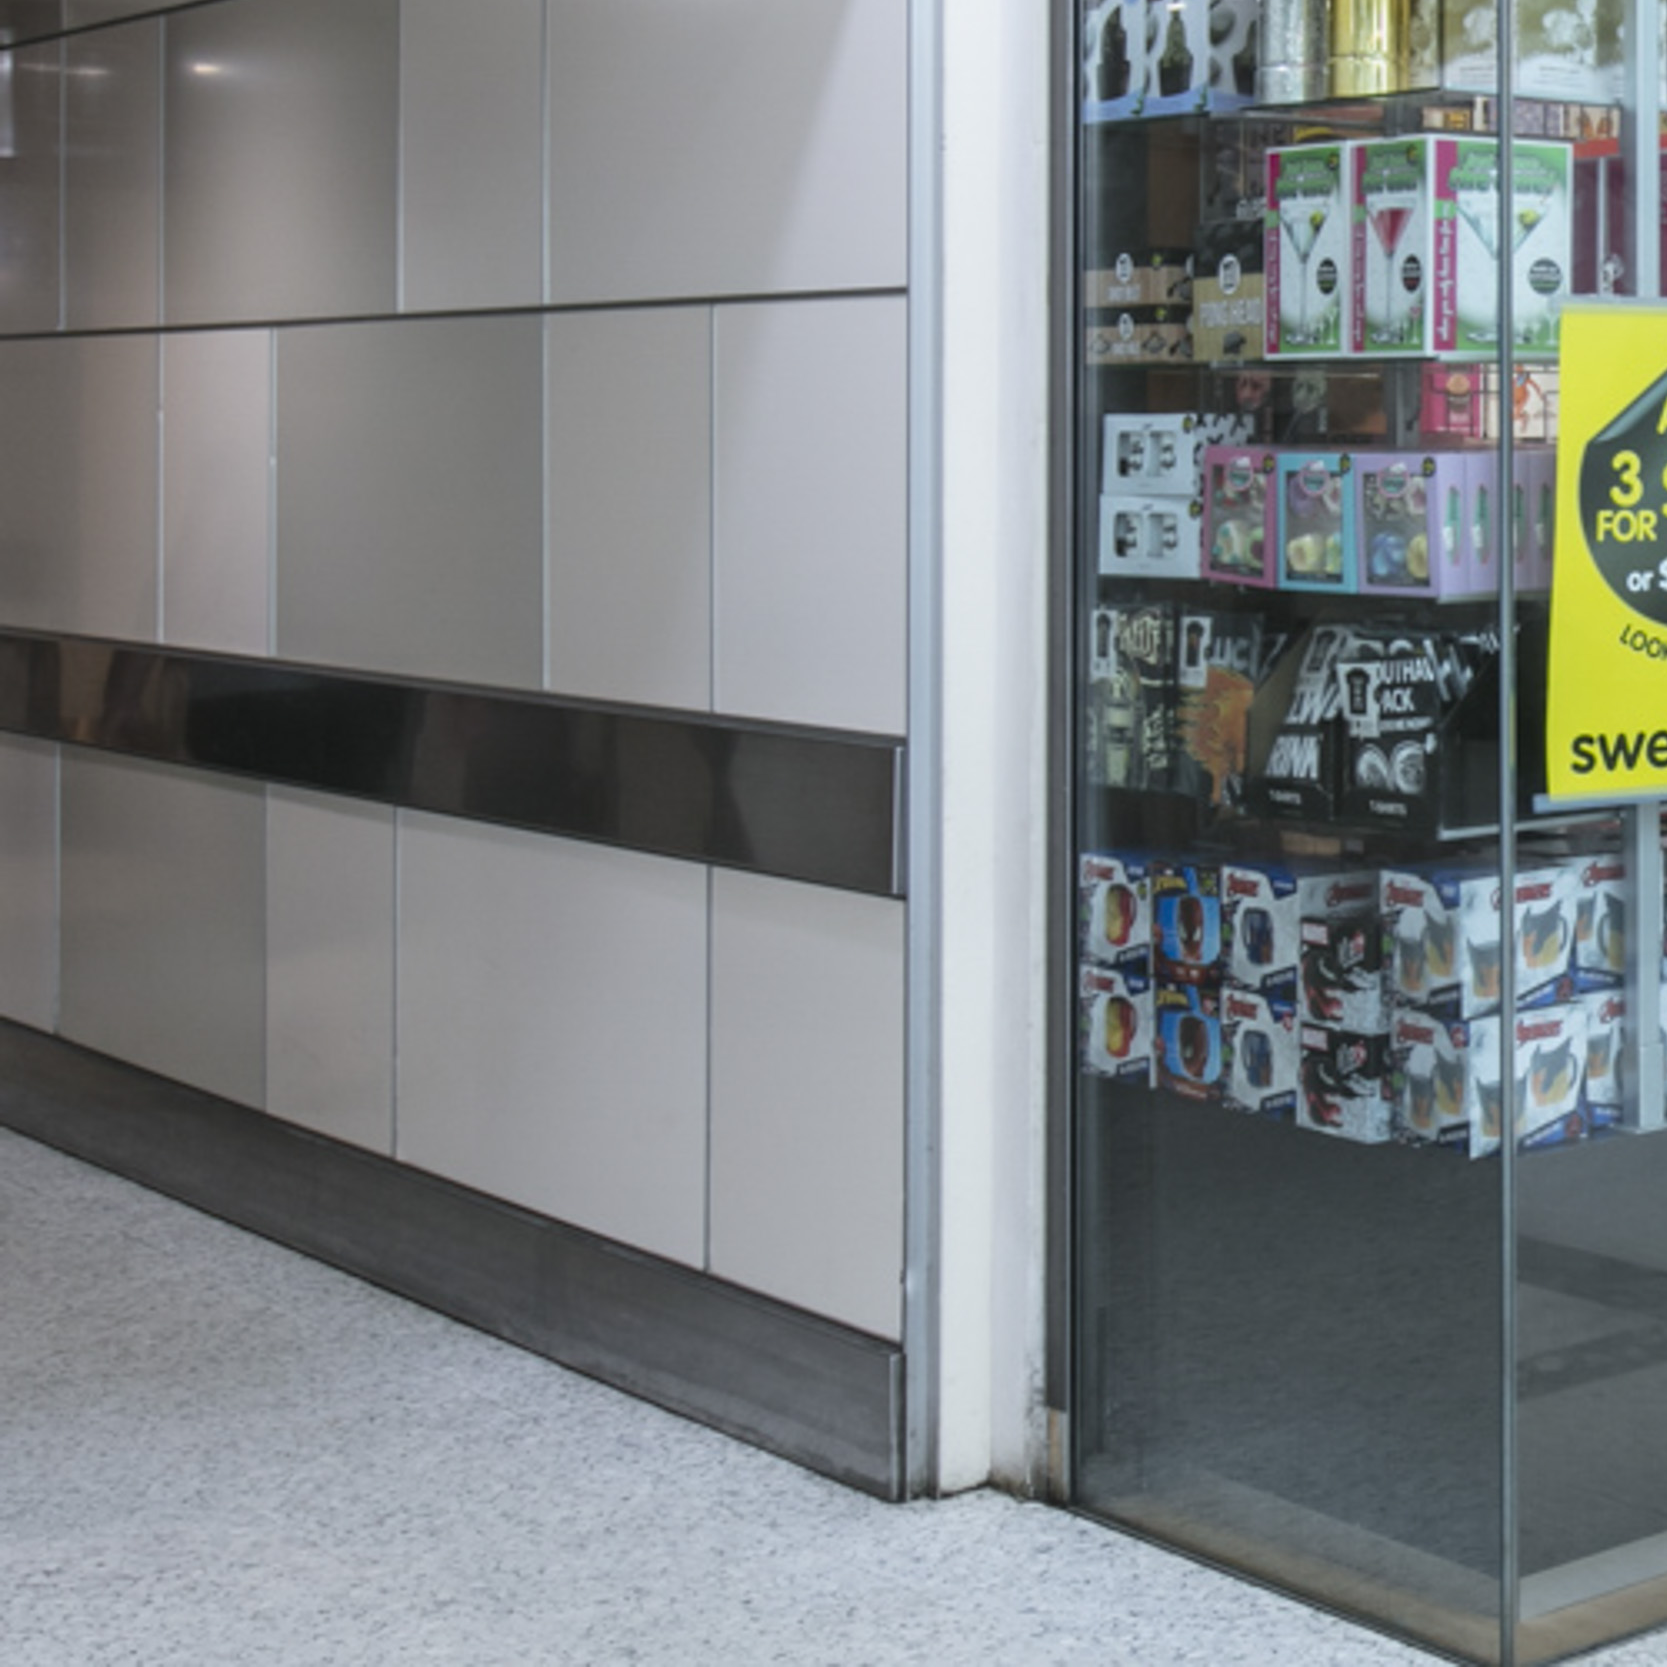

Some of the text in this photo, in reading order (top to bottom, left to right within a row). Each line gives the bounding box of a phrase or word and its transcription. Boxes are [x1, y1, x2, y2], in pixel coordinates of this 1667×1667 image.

[1609, 450, 1645, 506] 3
[1596, 510, 1658, 543] FOR
[1626, 568, 1655, 593] or
